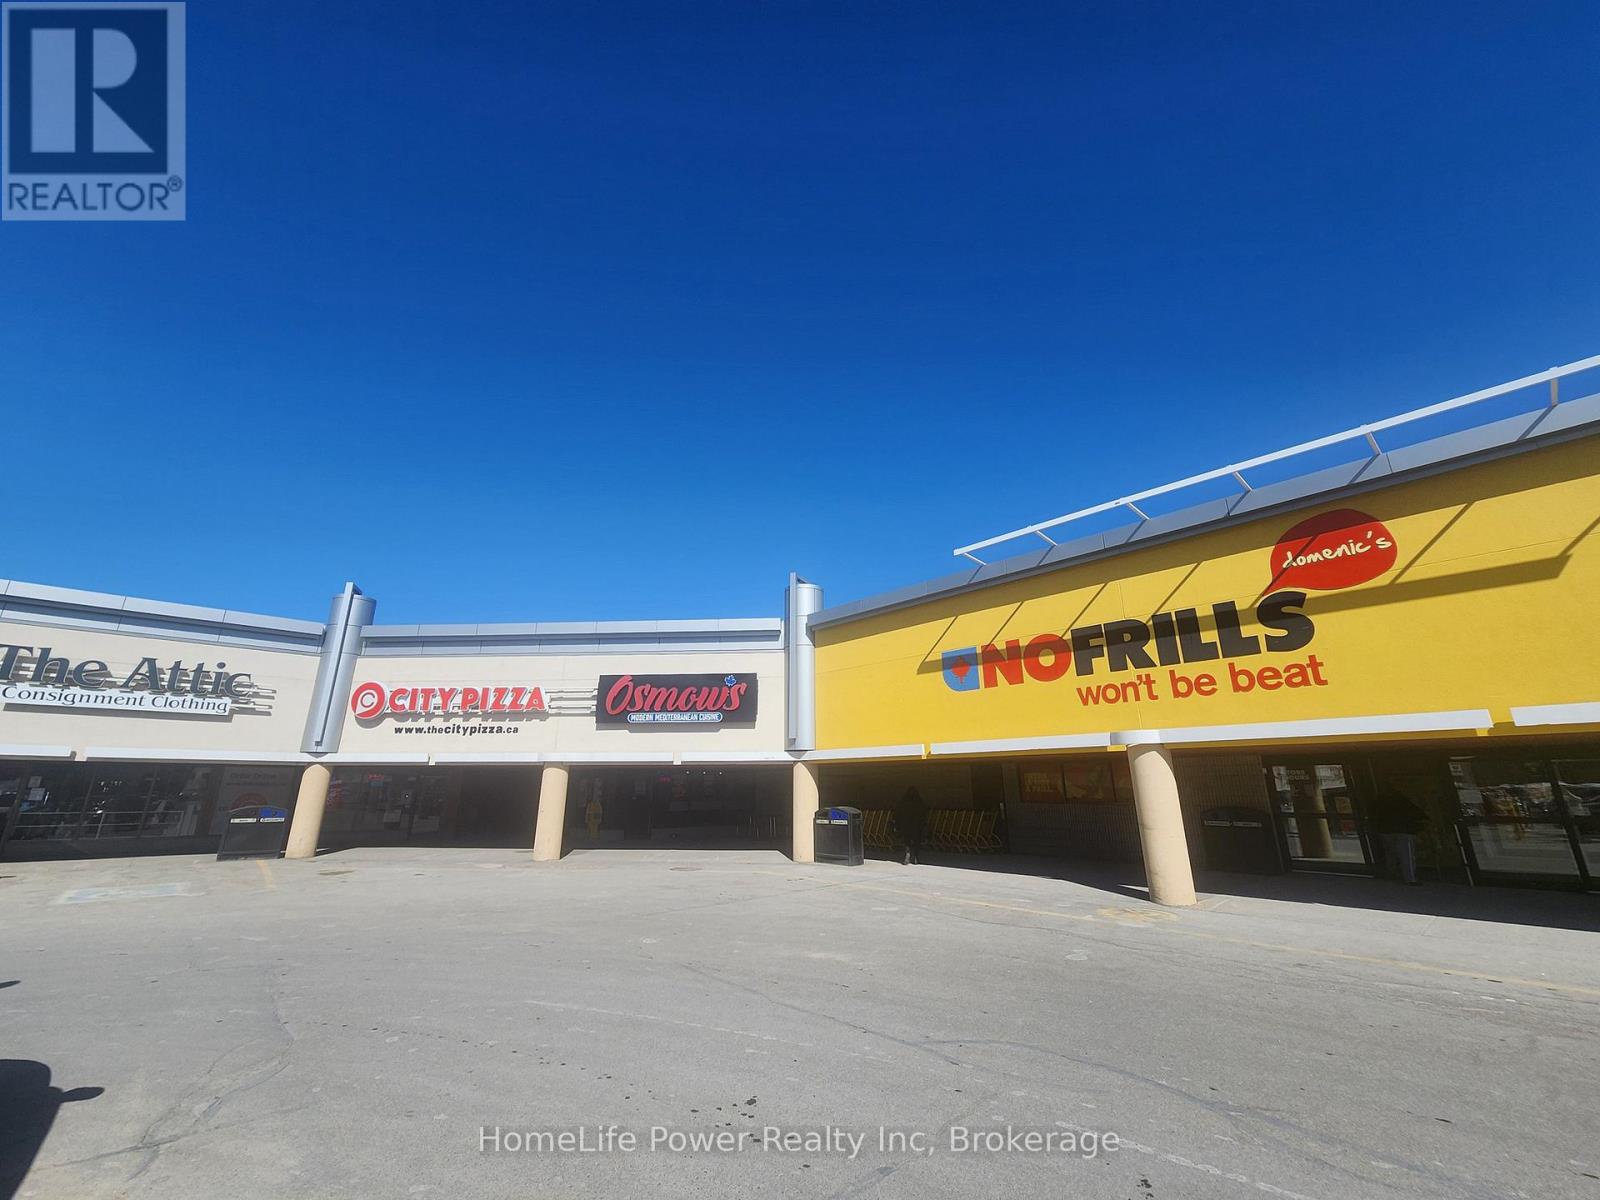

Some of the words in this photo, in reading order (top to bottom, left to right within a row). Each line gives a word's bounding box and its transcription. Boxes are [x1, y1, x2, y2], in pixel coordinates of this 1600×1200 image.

[1281, 531, 1392, 569] domenic's
[0, 643, 108, 688] The
[120, 656, 252, 697] Attic
[1076, 673, 1159, 707] won't
[1169, 668, 1219, 700] be
[1228, 654, 1328, 694] beat
[1, 686, 146, 707] Consignment
[151, 695, 228, 714] Clothing
[394, 724, 519, 737] www.thecitypizza.ca
[630, 714, 653, 722] MODERN
[655, 713, 698, 722] MEDITERRANEAN
[699, 713, 720, 721] CUISINE
